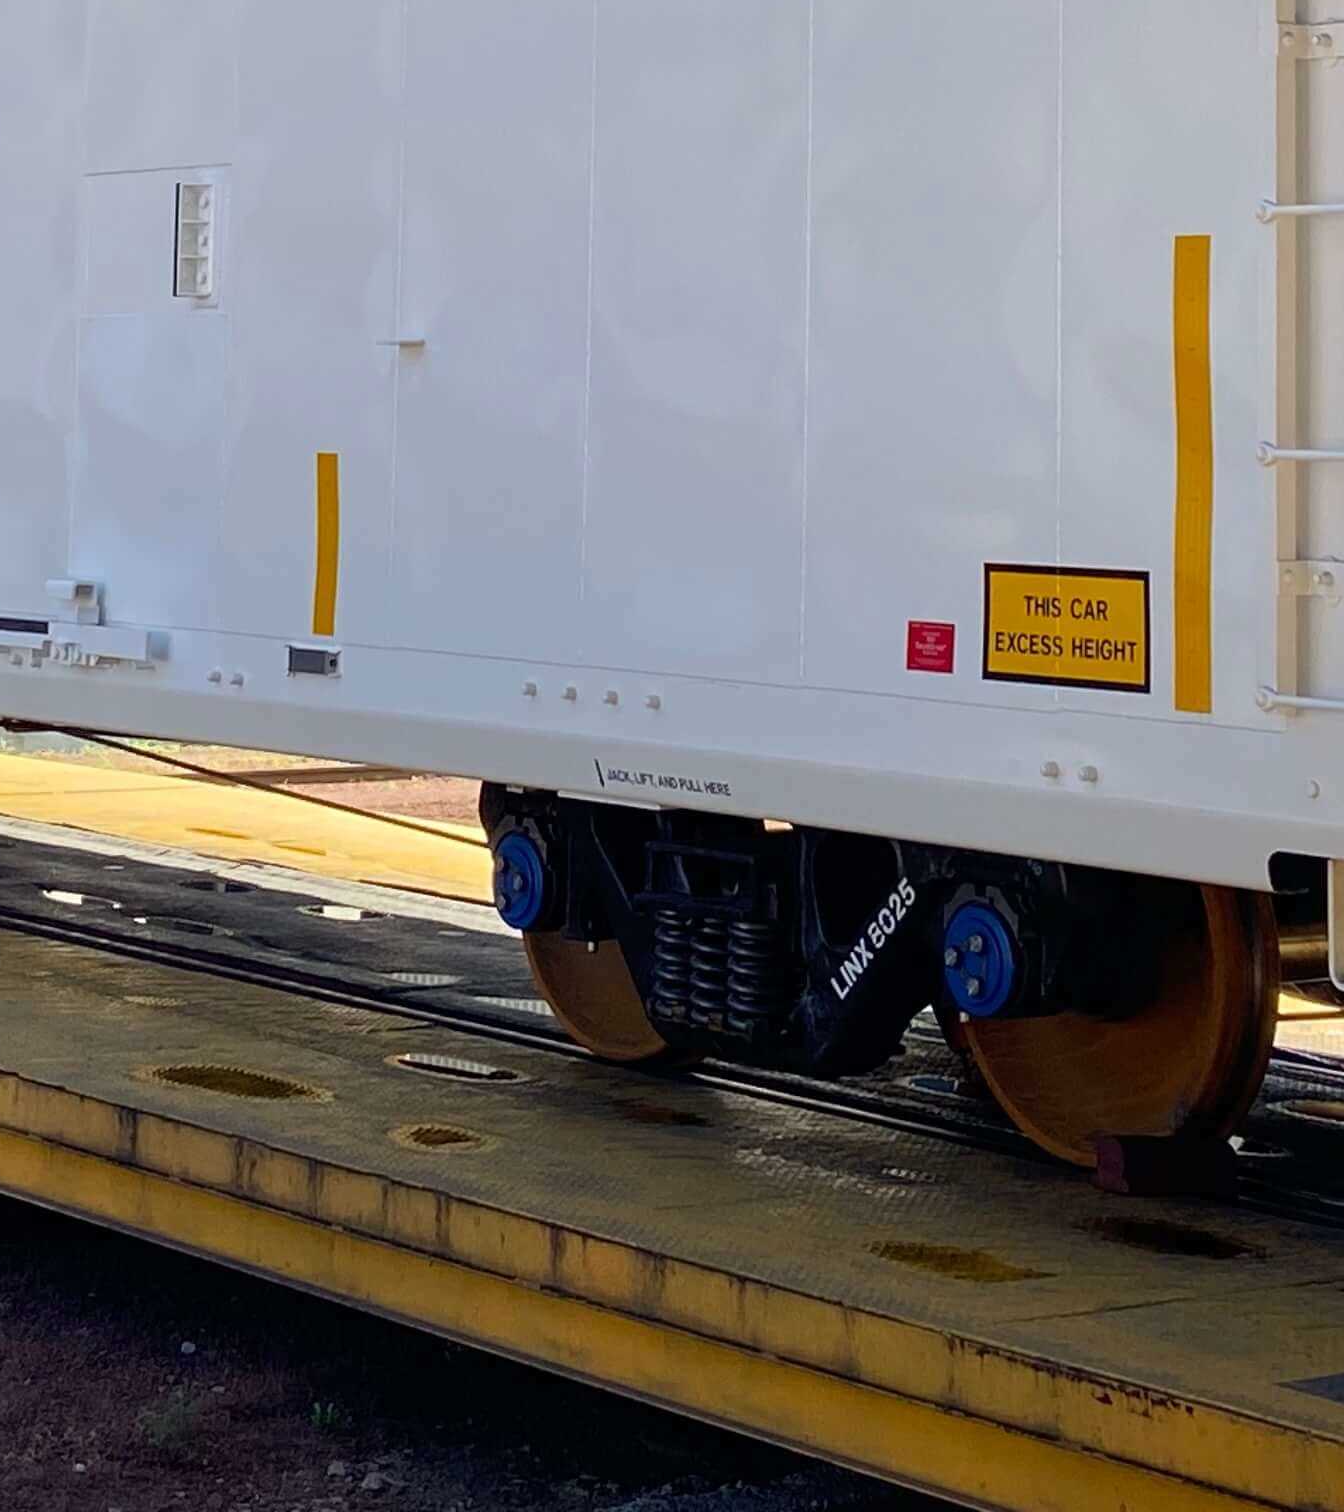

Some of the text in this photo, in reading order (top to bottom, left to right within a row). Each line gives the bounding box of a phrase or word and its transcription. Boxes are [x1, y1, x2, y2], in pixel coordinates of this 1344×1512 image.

[1024, 595, 1109, 622] THIS CAR
[994, 631, 1137, 664] EXCESS HEIGHT
[658, 775, 678, 789] AND
[678, 778, 703, 793] PULL
[705, 783, 732, 797] HERE
[830, 877, 915, 1000] LINX 8025
